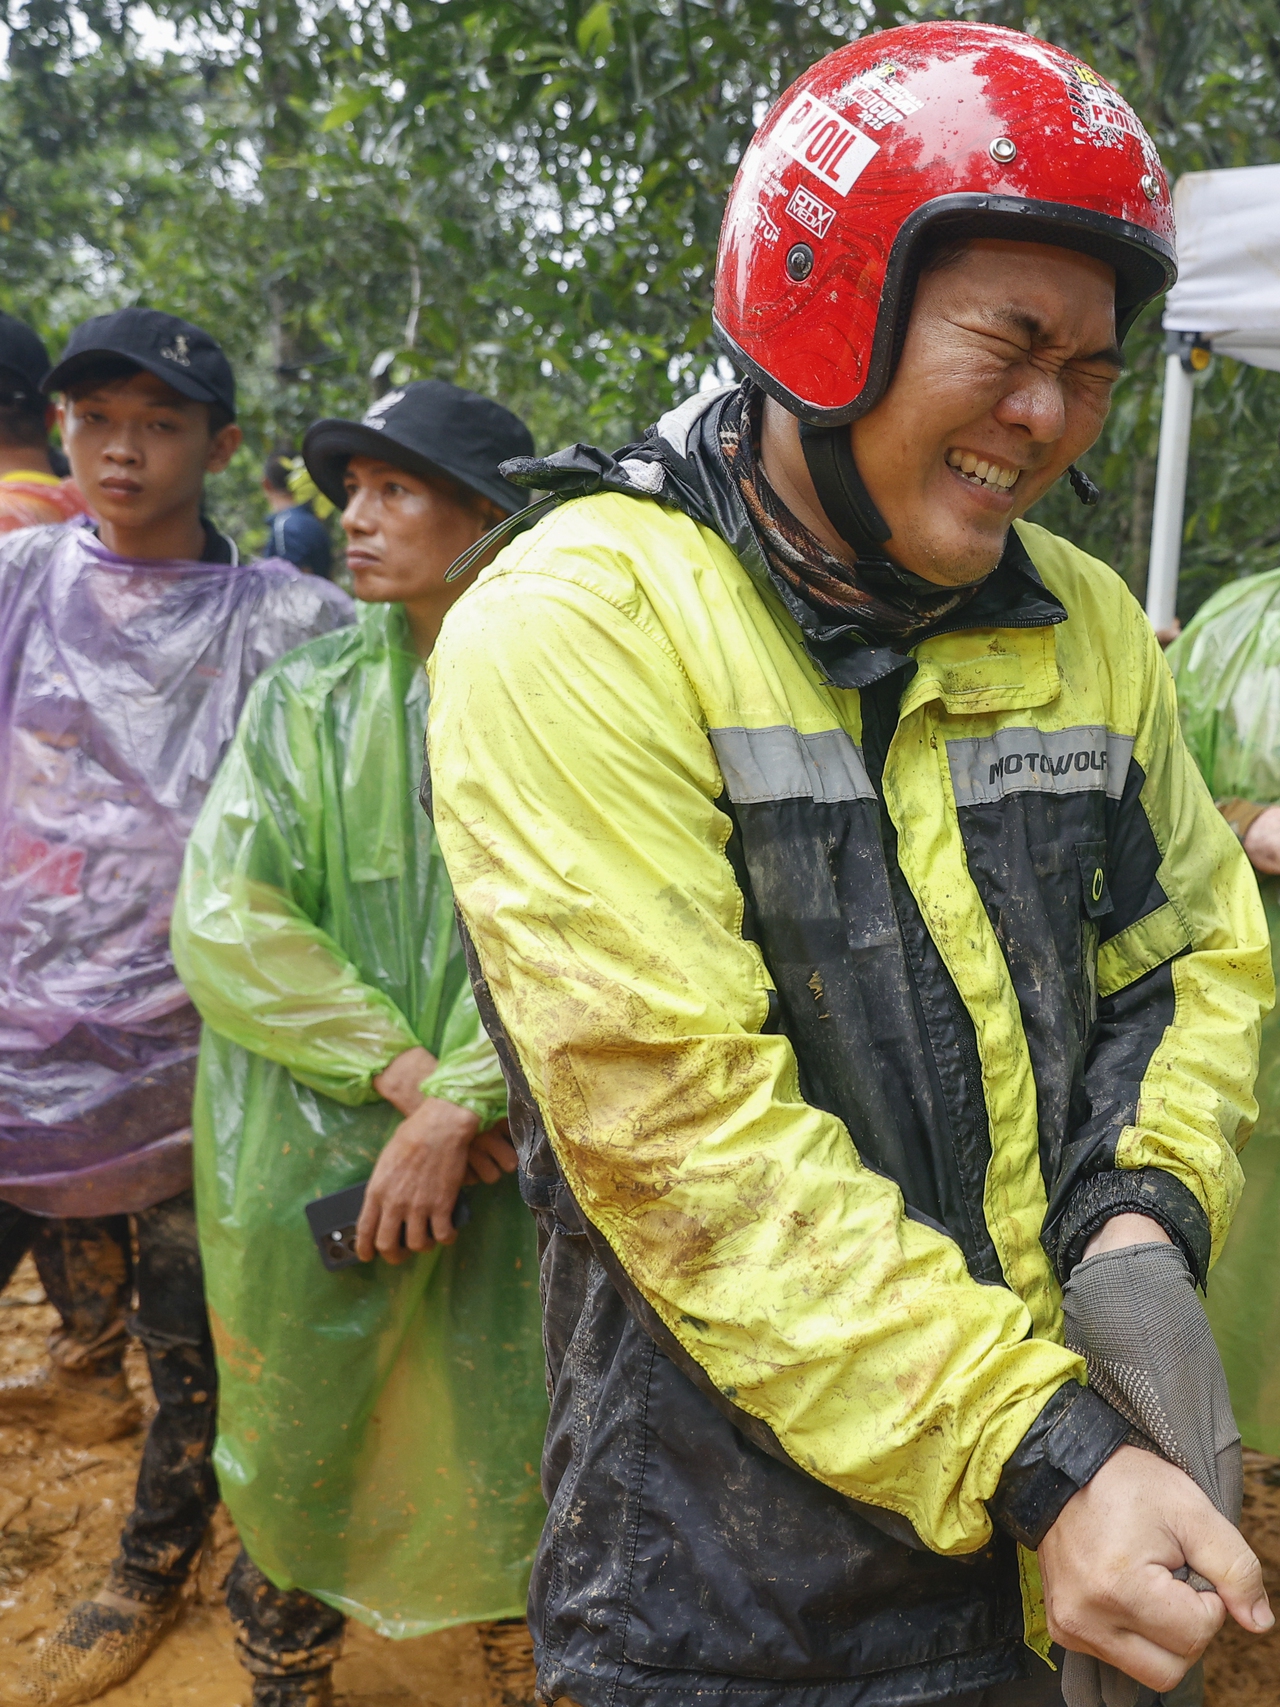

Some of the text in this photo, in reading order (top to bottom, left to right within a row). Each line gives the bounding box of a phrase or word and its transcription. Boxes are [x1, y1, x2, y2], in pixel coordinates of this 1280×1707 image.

[1073, 65, 1100, 86] 18
[857, 109, 884, 131] 2025
[868, 100, 905, 124] CUP
[779, 99, 857, 182] PVOIL
[789, 201, 824, 237] MEDIA
